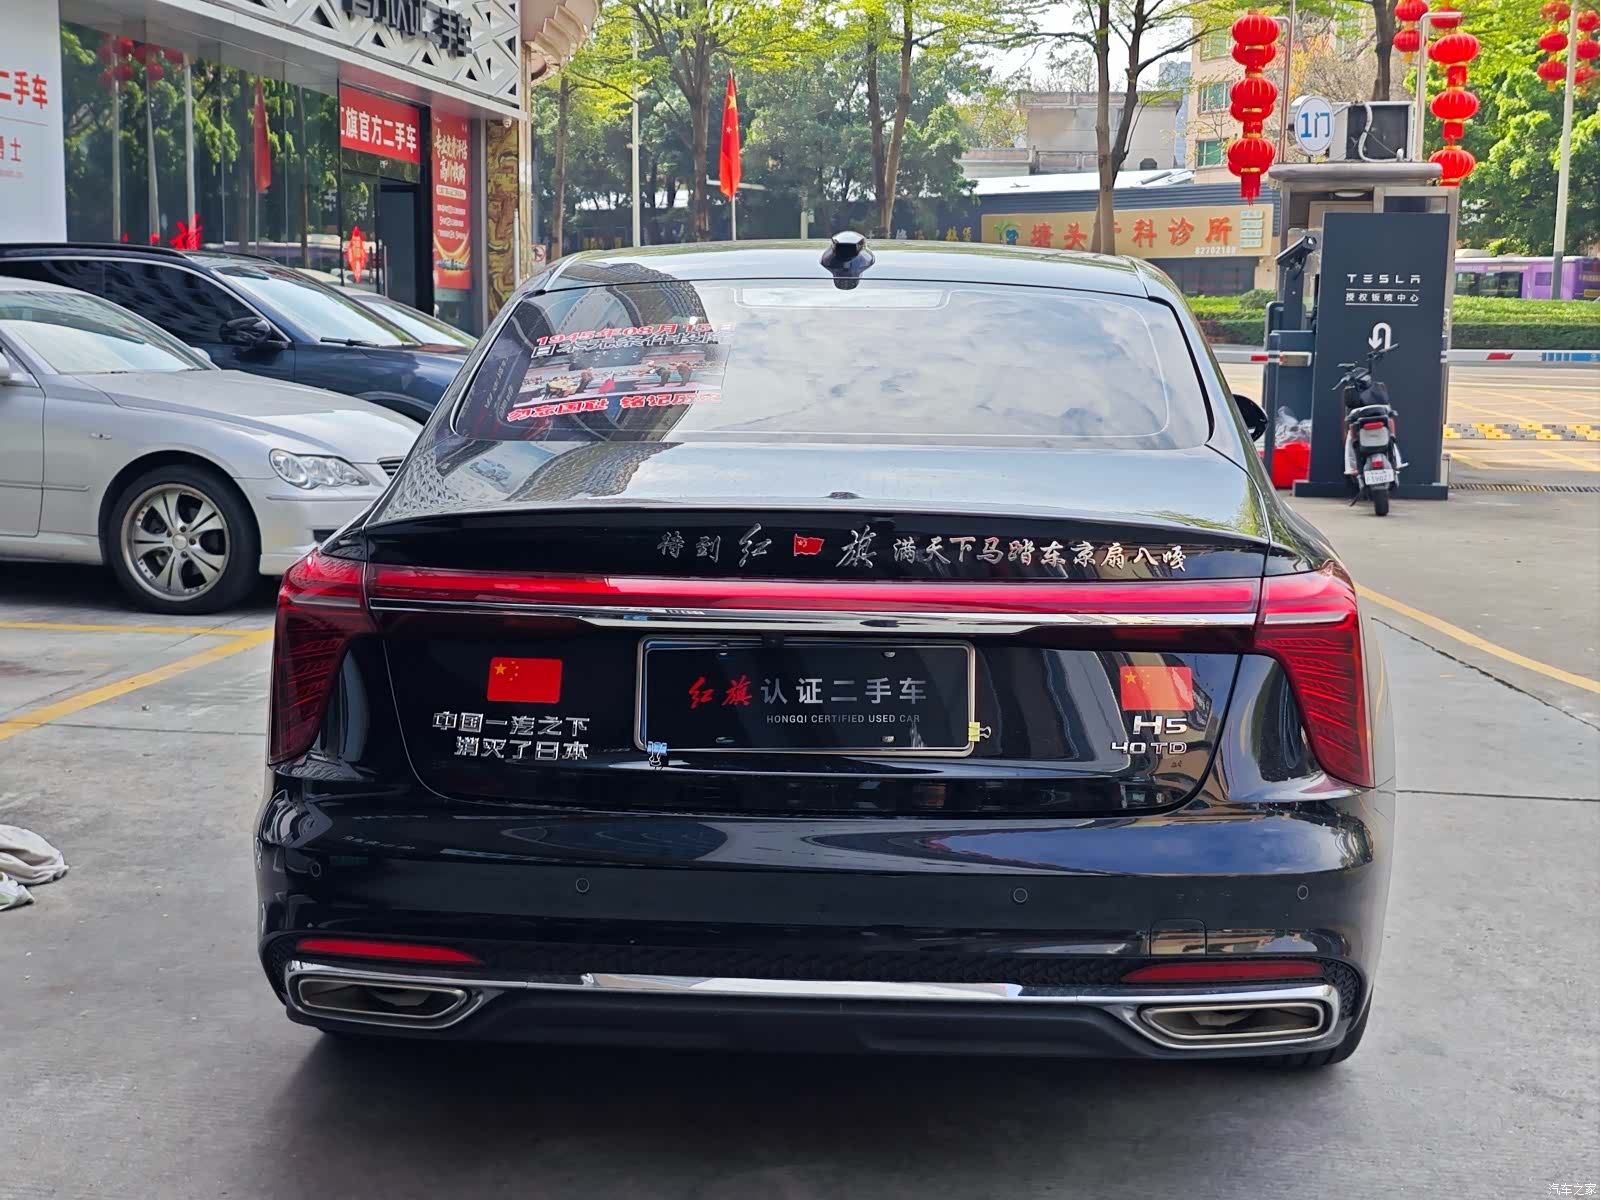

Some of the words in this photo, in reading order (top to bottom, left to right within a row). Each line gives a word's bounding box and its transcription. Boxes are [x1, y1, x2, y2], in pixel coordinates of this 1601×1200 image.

[1300, 111, 1331, 139] 1门
[1030, 215, 1232, 249] 塘头科诊所
[1346, 273, 1421, 284] TESLA
[766, 714, 808, 724] HONGQI
[811, 714, 865, 724] CERTIFIED
[868, 714, 896, 724] USED
[899, 714, 921, 724] CAR
[1132, 715, 1188, 735] H5
[454, 736, 589, 760] 消灭了日本
